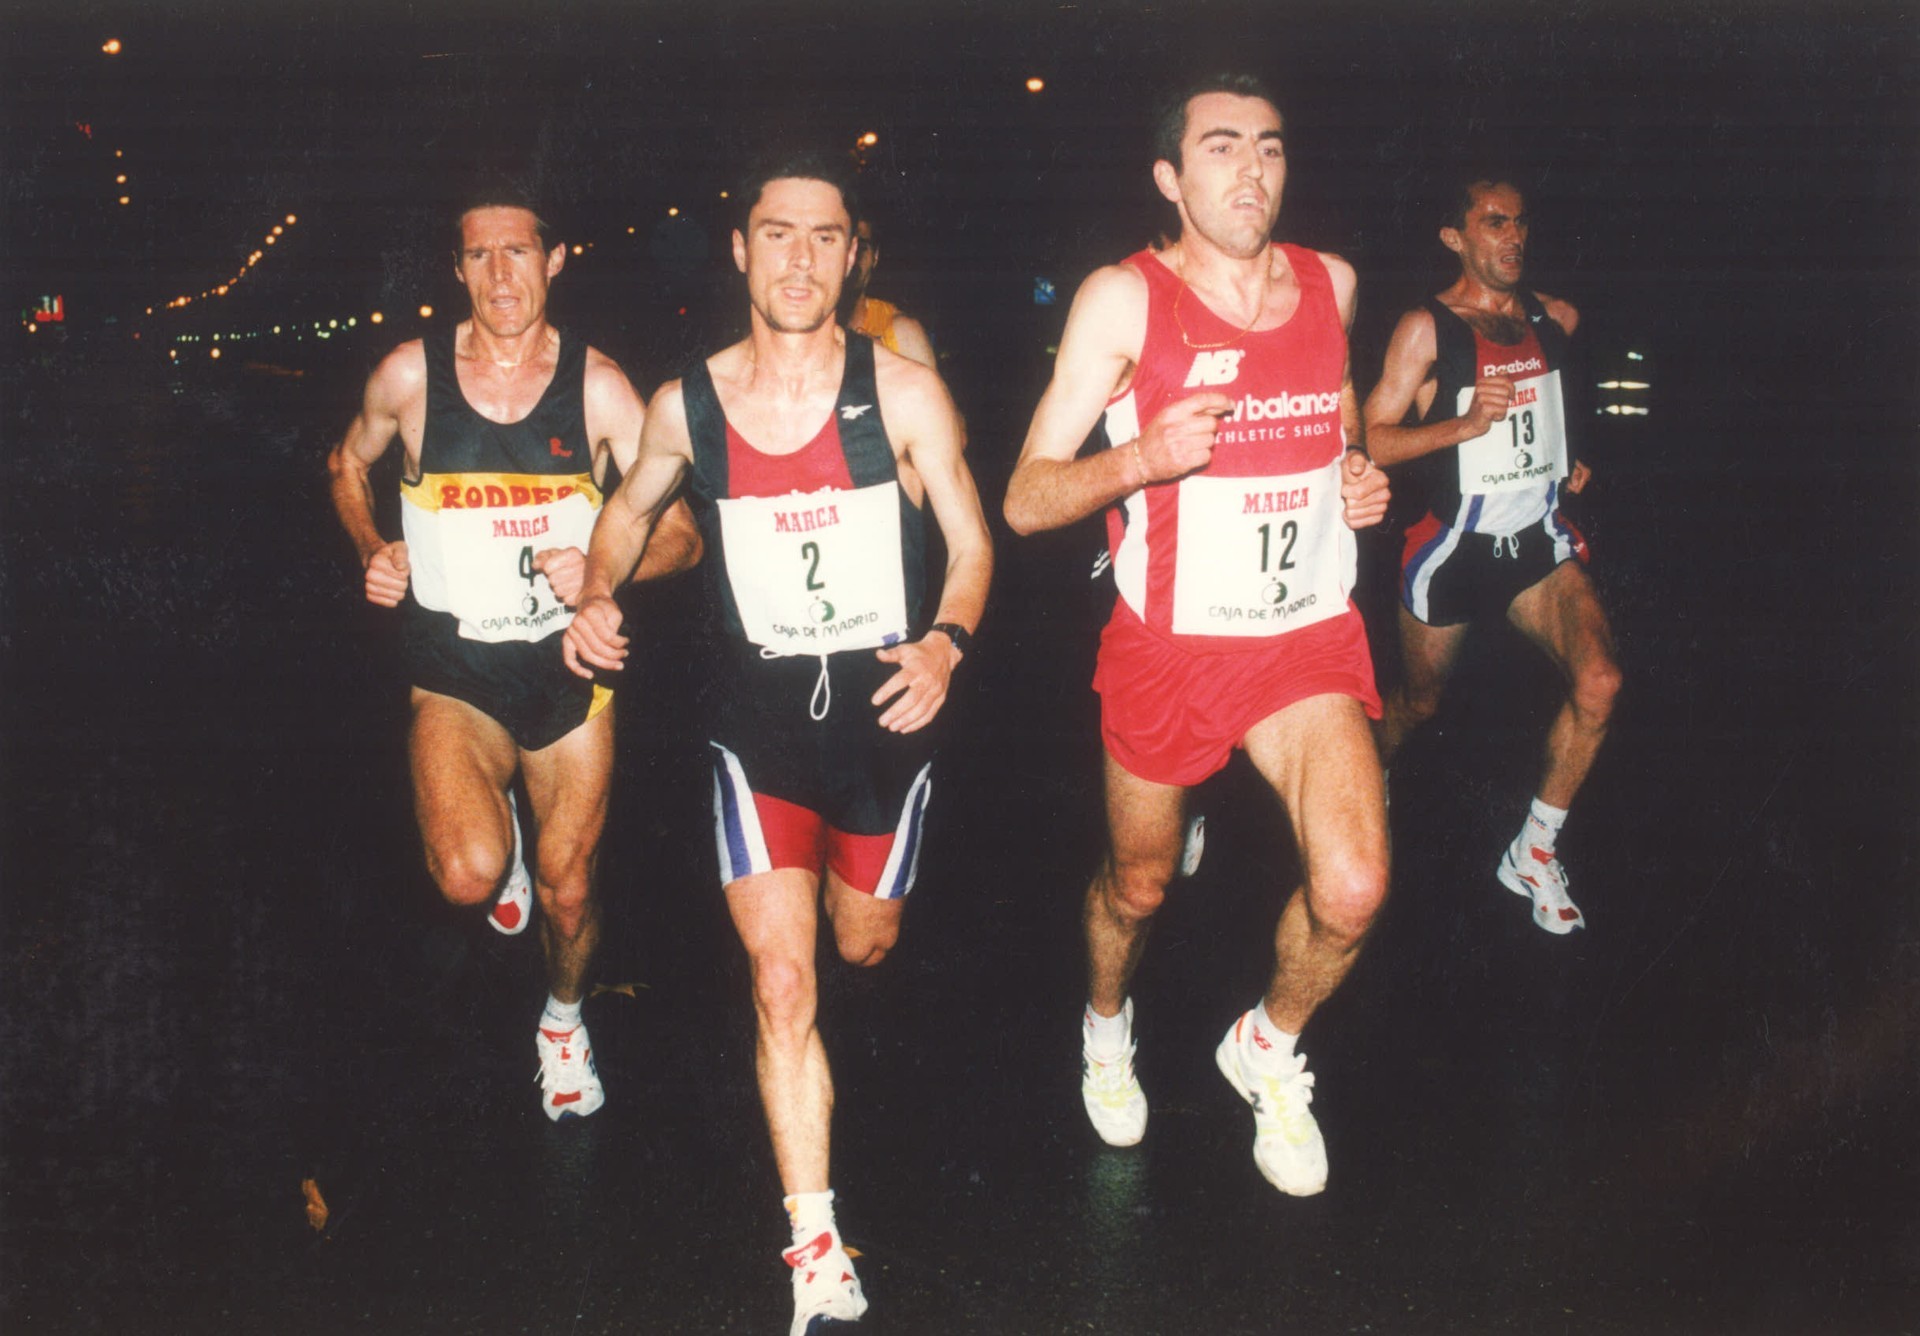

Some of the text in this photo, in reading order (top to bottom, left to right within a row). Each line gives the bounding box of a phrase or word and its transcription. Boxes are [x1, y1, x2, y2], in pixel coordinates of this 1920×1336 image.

[1508, 387, 1537, 408] ARCA
[1214, 426, 1286, 444] THLETIC
[1508, 410, 1535, 448] 13
[1481, 474, 1505, 485] CAJA
[1507, 472, 1519, 481] DE
[1242, 486, 1310, 514] MARCA
[492, 515, 549, 537] MARCA
[773, 505, 840, 533] MARCA
[1257, 519, 1299, 573] 12
[518, 545, 536, 588] 4
[801, 541, 825, 592] 2
[1208, 593, 1317, 621] CAJA DE MADRID
[481, 616, 511, 630] CAJA
[514, 616, 529, 627] DE
[772, 612, 879, 638] CAJA DE MADRID
